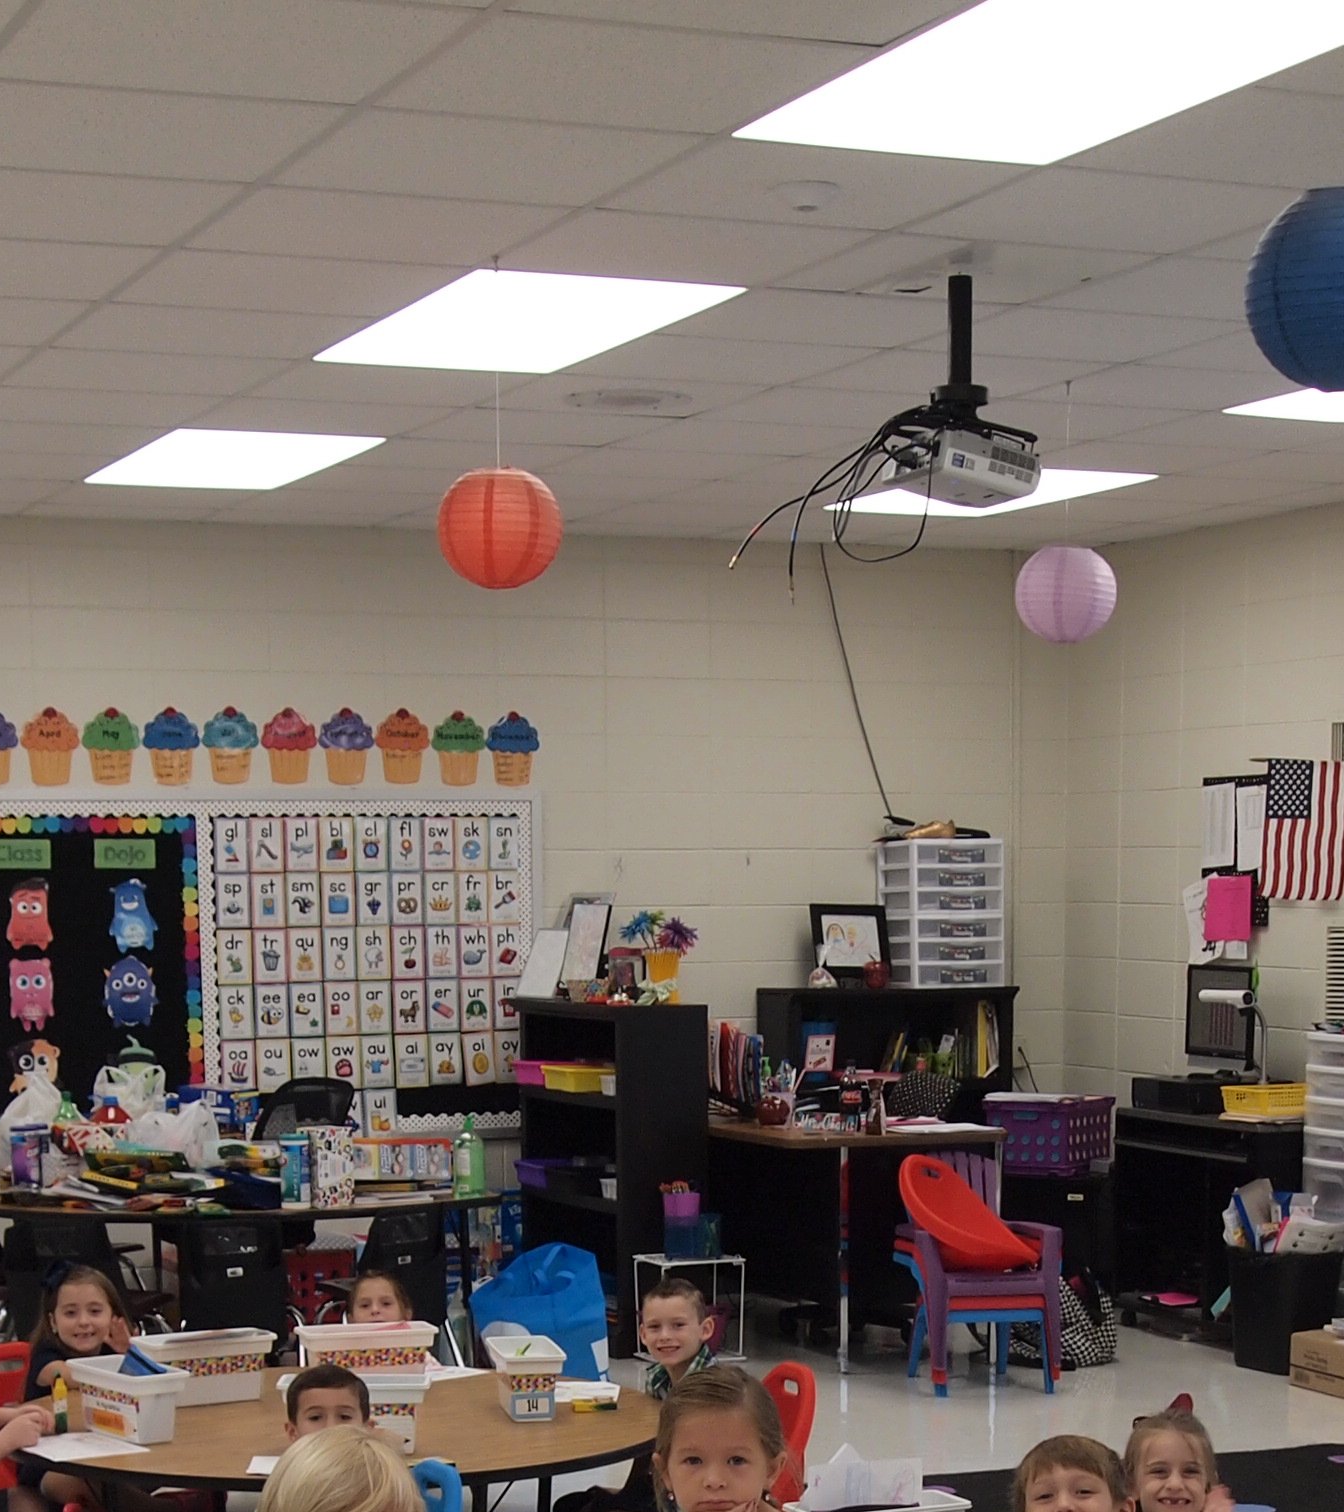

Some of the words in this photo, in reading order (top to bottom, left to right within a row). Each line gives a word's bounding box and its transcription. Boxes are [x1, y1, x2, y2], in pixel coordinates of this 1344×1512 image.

[38, 729, 61, 739] April
[102, 730, 120, 741] May
[386, 729, 420, 740] October
[437, 731, 481, 741] November
[225, 822, 238, 842] gl
[261, 822, 272, 837] sl
[295, 822, 308, 841] pl
[330, 822, 343, 837] bl
[365, 822, 377, 837] cl
[400, 821, 411, 837] fl
[429, 827, 448, 837] sw
[464, 822, 480, 837] sk
[496, 826, 512, 837] sn
[104, 846, 146, 865] Dojo
[261, 879, 276, 893] st
[292, 882, 314, 892] sm
[330, 882, 346, 892] sc
[364, 881, 381, 896] gr
[398, 882, 415, 895] pr
[432, 881, 448, 891] cr
[466, 875, 481, 891] fr
[496, 875, 512, 890] br
[224, 883, 241, 897] sp
[225, 934, 243, 950] dr
[262, 934, 278, 949] tr
[330, 936, 348, 950] ng
[365, 930, 382, 946] sh
[399, 930, 417, 946] ch
[434, 929, 450, 945] th
[465, 929, 485, 944] wh
[497, 929, 515, 947] ph
[296, 937, 314, 951] qu
[227, 990, 245, 1005] ck
[262, 994, 281, 1004] ee
[297, 992, 316, 1003] ea
[331, 991, 350, 1001] oo
[365, 990, 383, 1000] ar
[400, 989, 418, 1000] or
[434, 988, 452, 998] er
[467, 988, 484, 998] ur
[264, 1049, 283, 1059] ou
[298, 1048, 319, 1058] ow
[331, 1046, 354, 1056] aw
[367, 1044, 386, 1055] au
[435, 1042, 454, 1055] ay
[502, 1040, 518, 1055] oy
[228, 1050, 248, 1060] oa
[527, 1399, 538, 1412] 14
